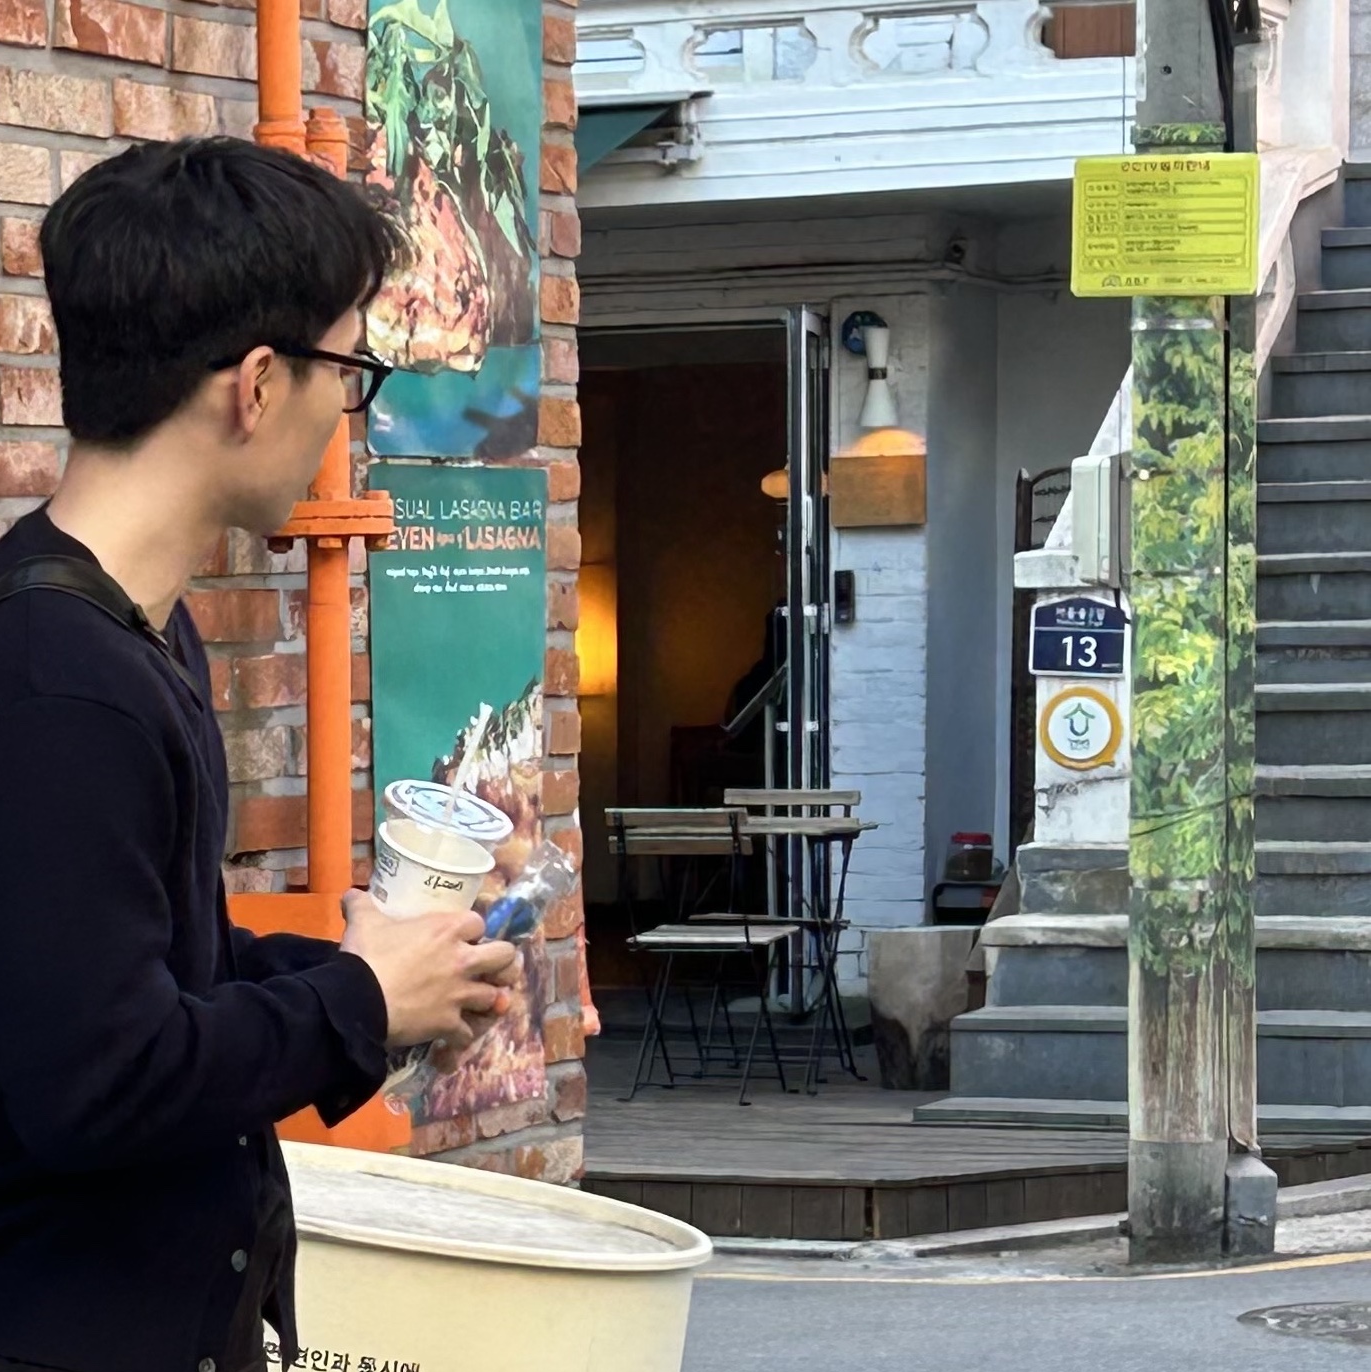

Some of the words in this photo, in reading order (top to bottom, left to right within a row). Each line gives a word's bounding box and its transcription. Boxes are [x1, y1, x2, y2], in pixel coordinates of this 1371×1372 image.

[440, 498, 506, 521] LASAGNA
[509, 500, 542, 520] BAR
[1062, 635, 1098, 667] 13
